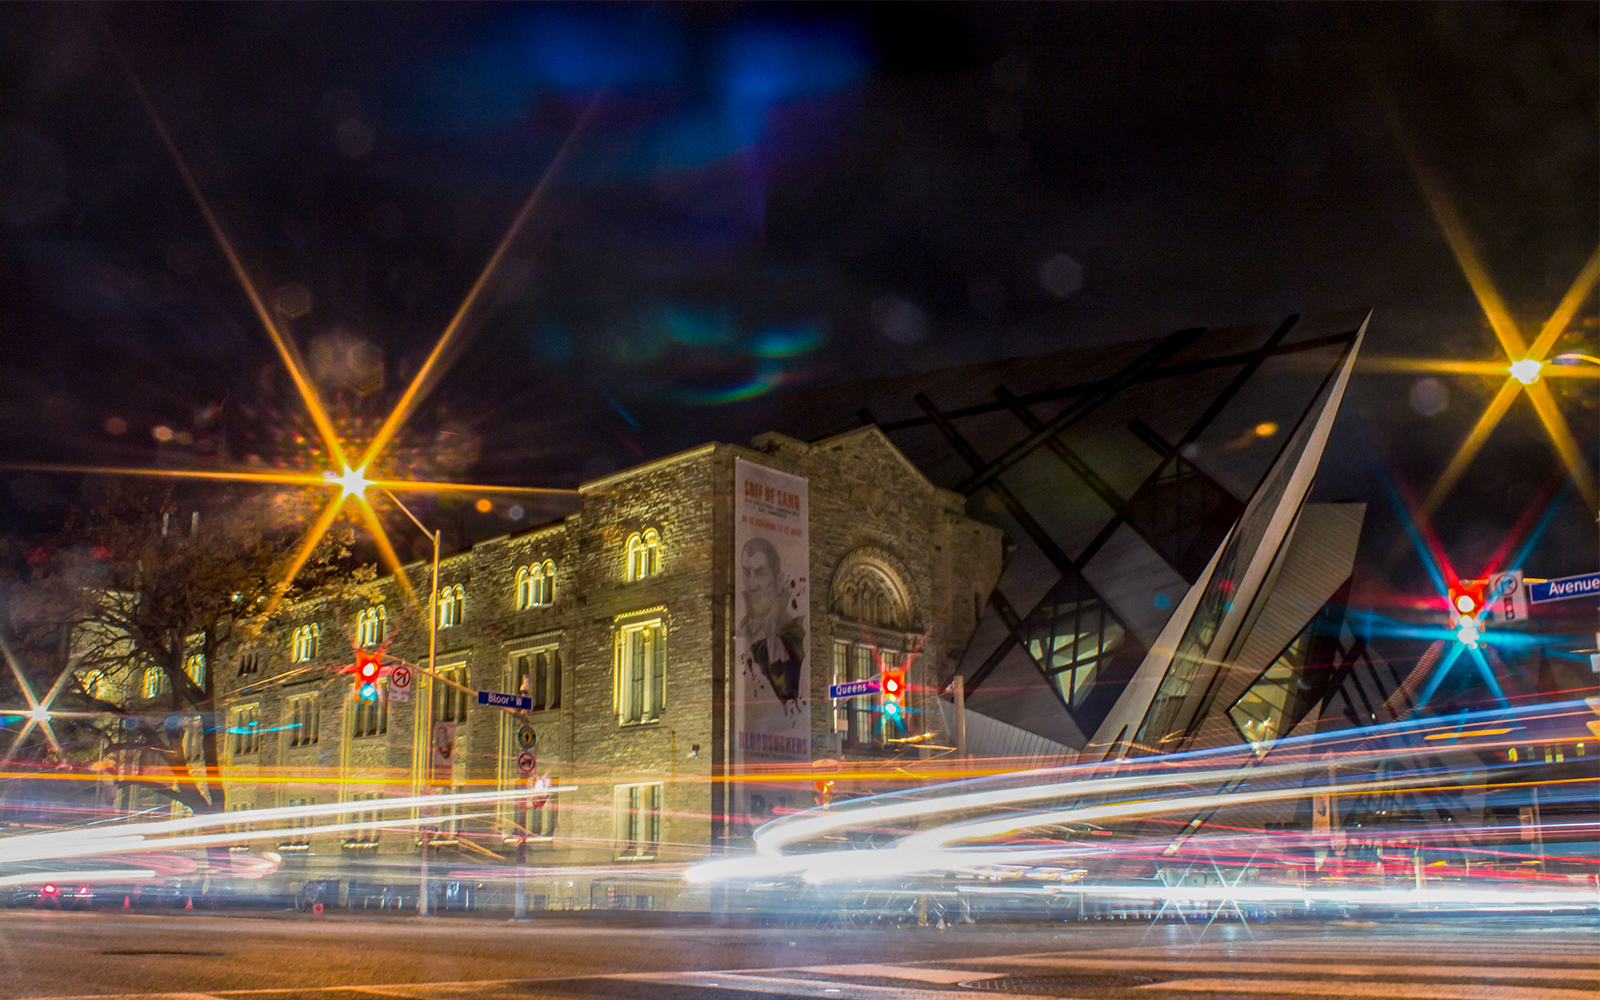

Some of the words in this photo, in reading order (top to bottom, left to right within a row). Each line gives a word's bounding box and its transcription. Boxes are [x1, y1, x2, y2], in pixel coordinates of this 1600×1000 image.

[744, 480, 763, 500] SOIF
[765, 486, 775, 504] DE
[1549, 577, 1600, 597] Avenue
[488, 692, 510, 705] Bloor
[515, 696, 523, 706] W
[836, 683, 867, 696] Queens
[739, 731, 807, 755] BLOODSUCKERS
